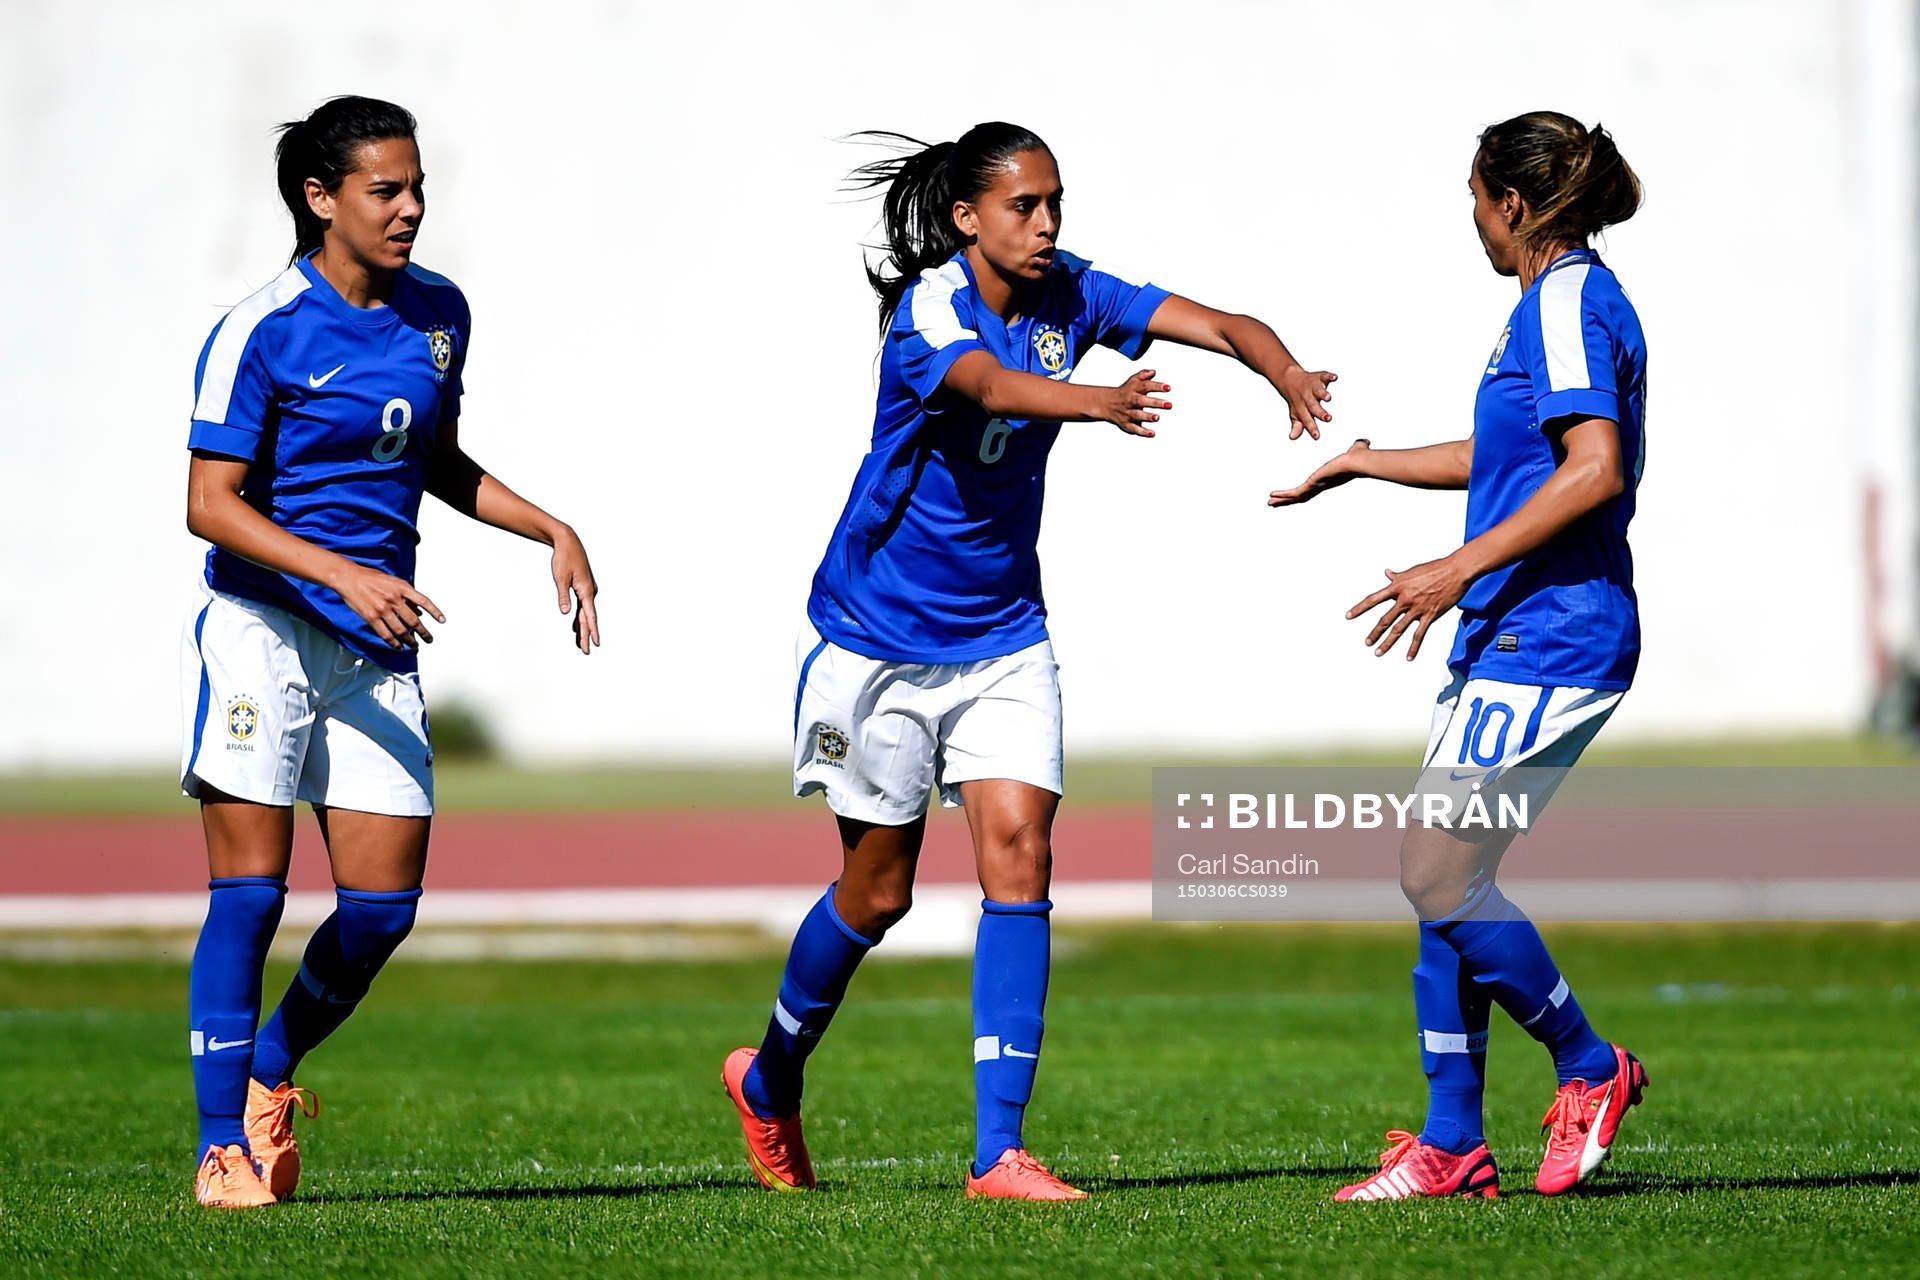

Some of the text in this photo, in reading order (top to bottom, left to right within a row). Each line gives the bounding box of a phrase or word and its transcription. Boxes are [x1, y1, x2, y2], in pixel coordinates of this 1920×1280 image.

[372, 398, 412, 463] 8
[979, 418, 1013, 464] 6
[226, 743, 255, 752] BRASIL
[1458, 697, 1515, 767] 10
[816, 758, 845, 770] BRASIL
